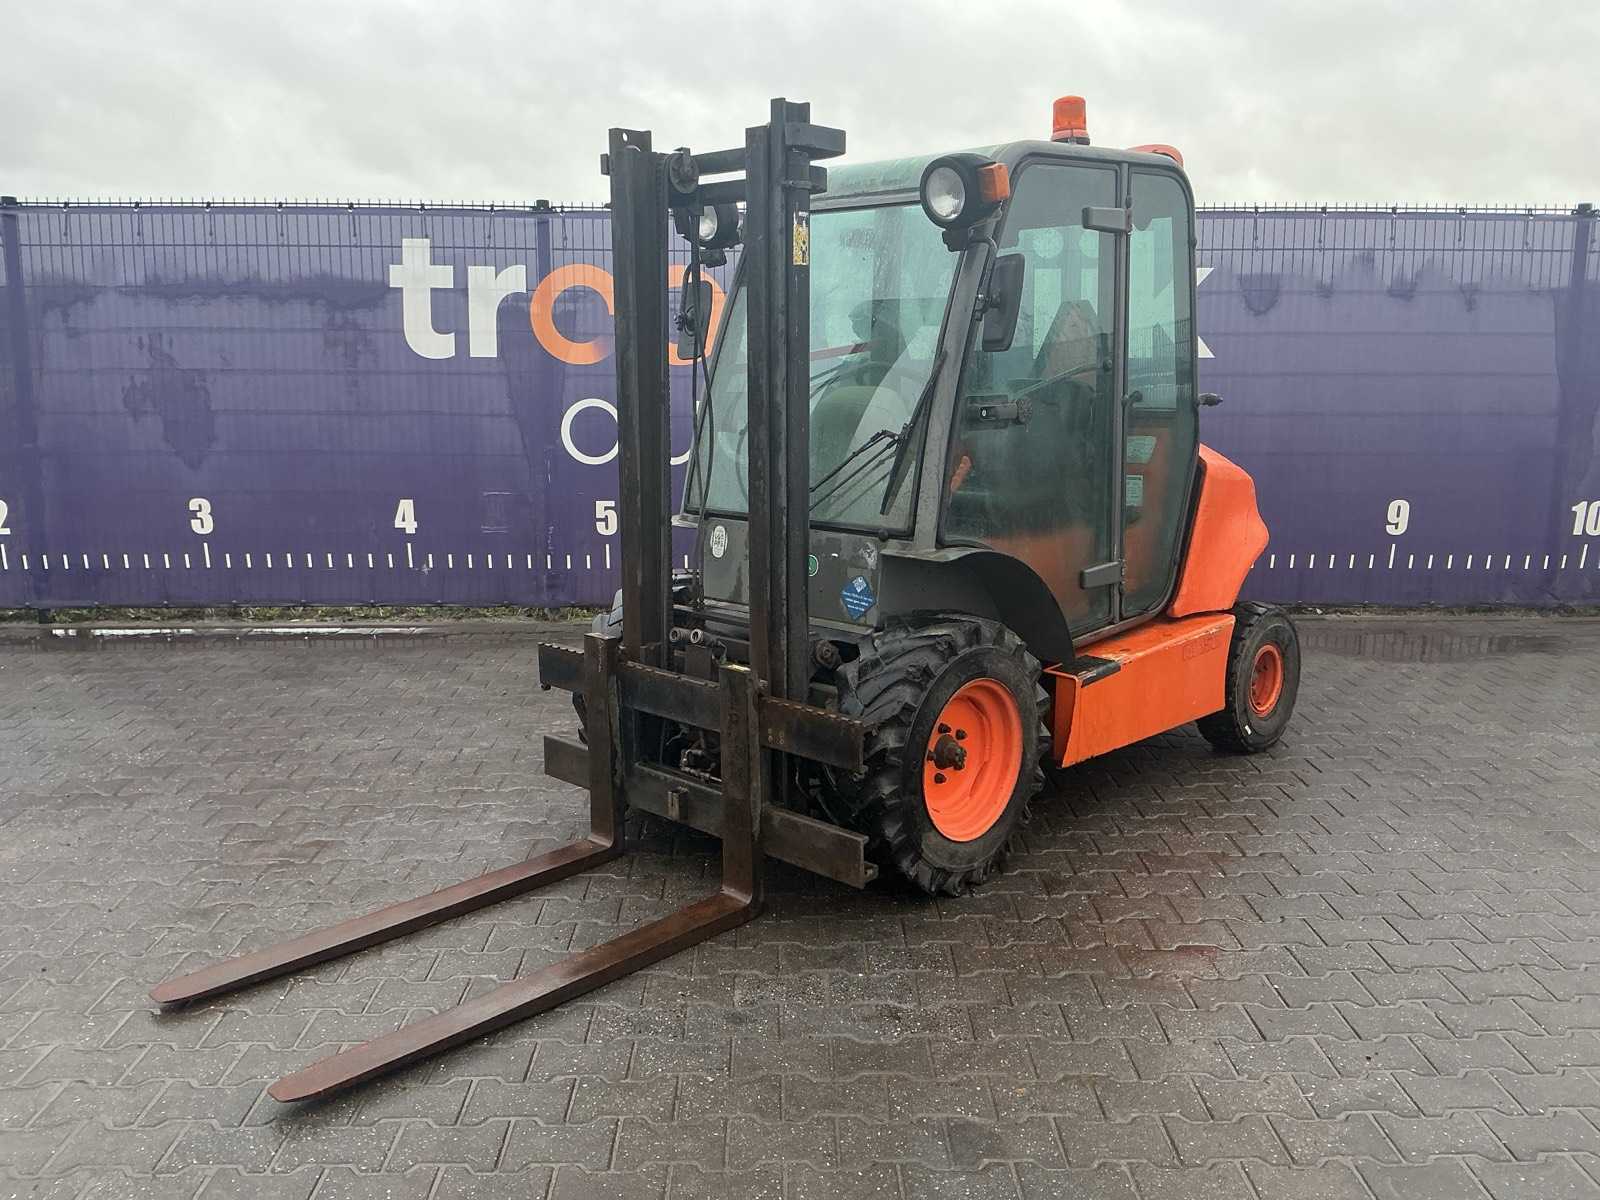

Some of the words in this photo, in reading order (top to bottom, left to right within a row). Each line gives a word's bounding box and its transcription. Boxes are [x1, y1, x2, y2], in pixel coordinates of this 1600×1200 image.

[188, 498, 214, 535] 3
[394, 499, 418, 534] 4
[595, 500, 618, 536] 5
[1385, 499, 1410, 536] 9
[1571, 500, 1600, 536] 10
